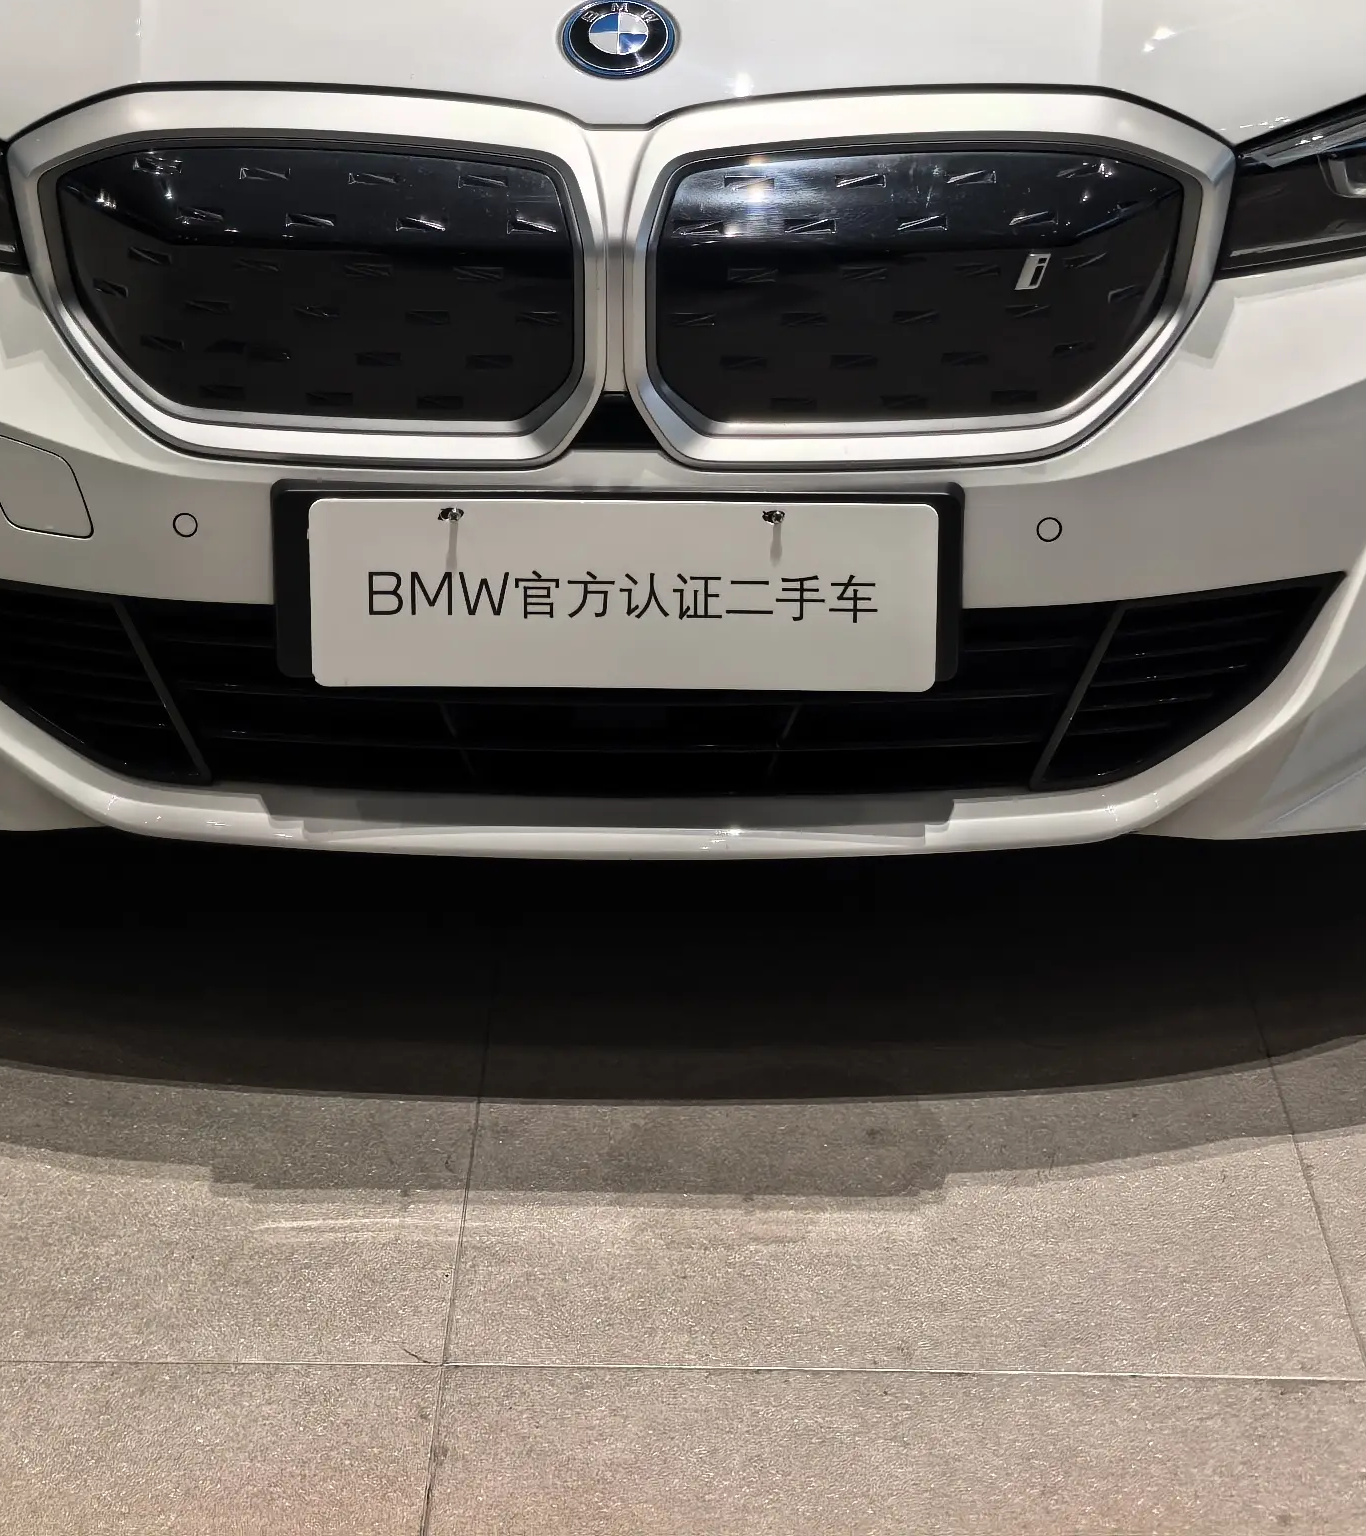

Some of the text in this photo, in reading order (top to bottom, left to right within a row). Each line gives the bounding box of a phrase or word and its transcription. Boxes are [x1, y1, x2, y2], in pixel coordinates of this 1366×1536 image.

[581, 2, 660, 24] BMW
[366, 570, 880, 624] BMW官方认证二手车
